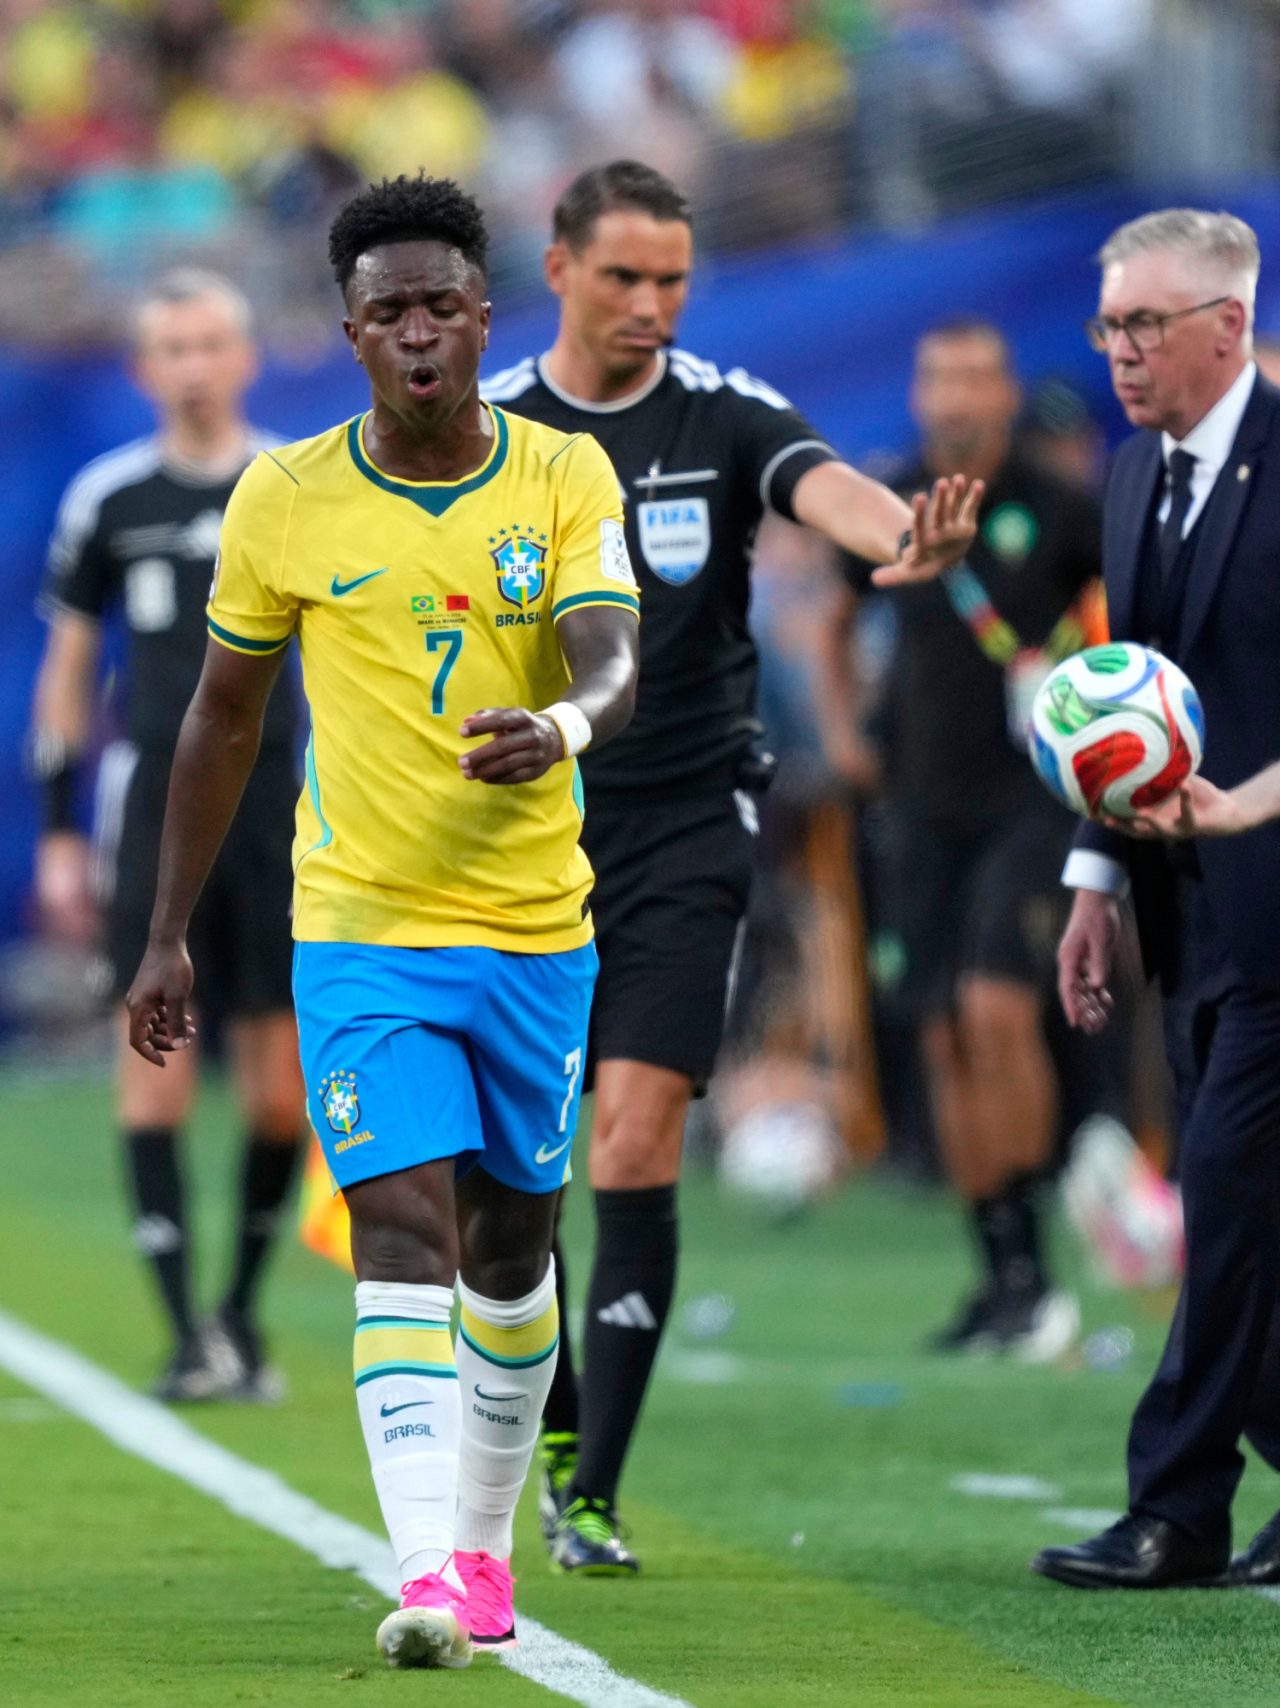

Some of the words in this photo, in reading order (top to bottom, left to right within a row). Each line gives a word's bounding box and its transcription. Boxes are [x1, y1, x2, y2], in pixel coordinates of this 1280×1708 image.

[647, 505, 700, 529] FIFA
[510, 565, 531, 575] CBF
[426, 629, 463, 715] 7
[558, 1046, 581, 1132] 7
[333, 1101, 348, 1112] CBF
[335, 1130, 376, 1154] BRASIL
[473, 1404, 525, 1426] BRASIL
[384, 1423, 437, 1444] BRASIL
